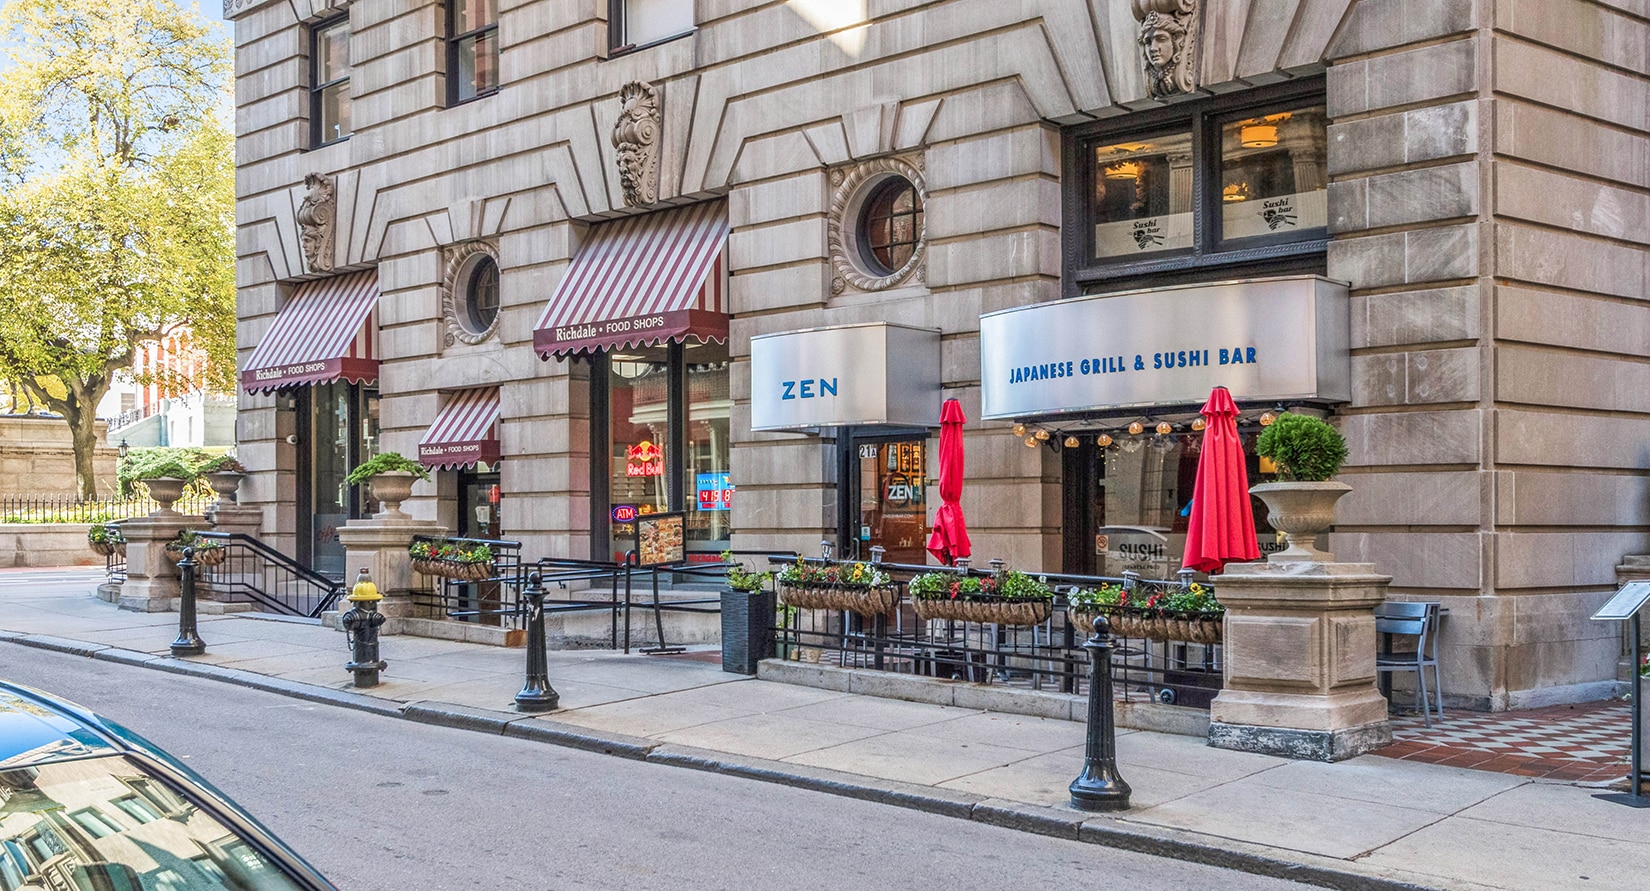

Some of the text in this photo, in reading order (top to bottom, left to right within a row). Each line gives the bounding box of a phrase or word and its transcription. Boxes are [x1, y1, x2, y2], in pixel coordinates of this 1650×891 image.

[1263, 197, 1289, 209] Sushi
[1132, 219, 1157, 229] Sushi
[555, 316, 664, 341] Richdale FOOD SHOPS
[255, 362, 326, 381] Richdale FOOD SHOPS
[1009, 347, 1257, 384] JAPANESE GRILL & SUSHI BAR
[782, 377, 838, 400] ZEN
[420, 446, 443, 455] Richdale
[463, 444, 479, 452] SHOPS
[859, 445, 877, 458] 21A
[627, 461, 664, 476] Red Bull
[888, 484, 913, 500] ZEN
[616, 508, 634, 519] ATM
